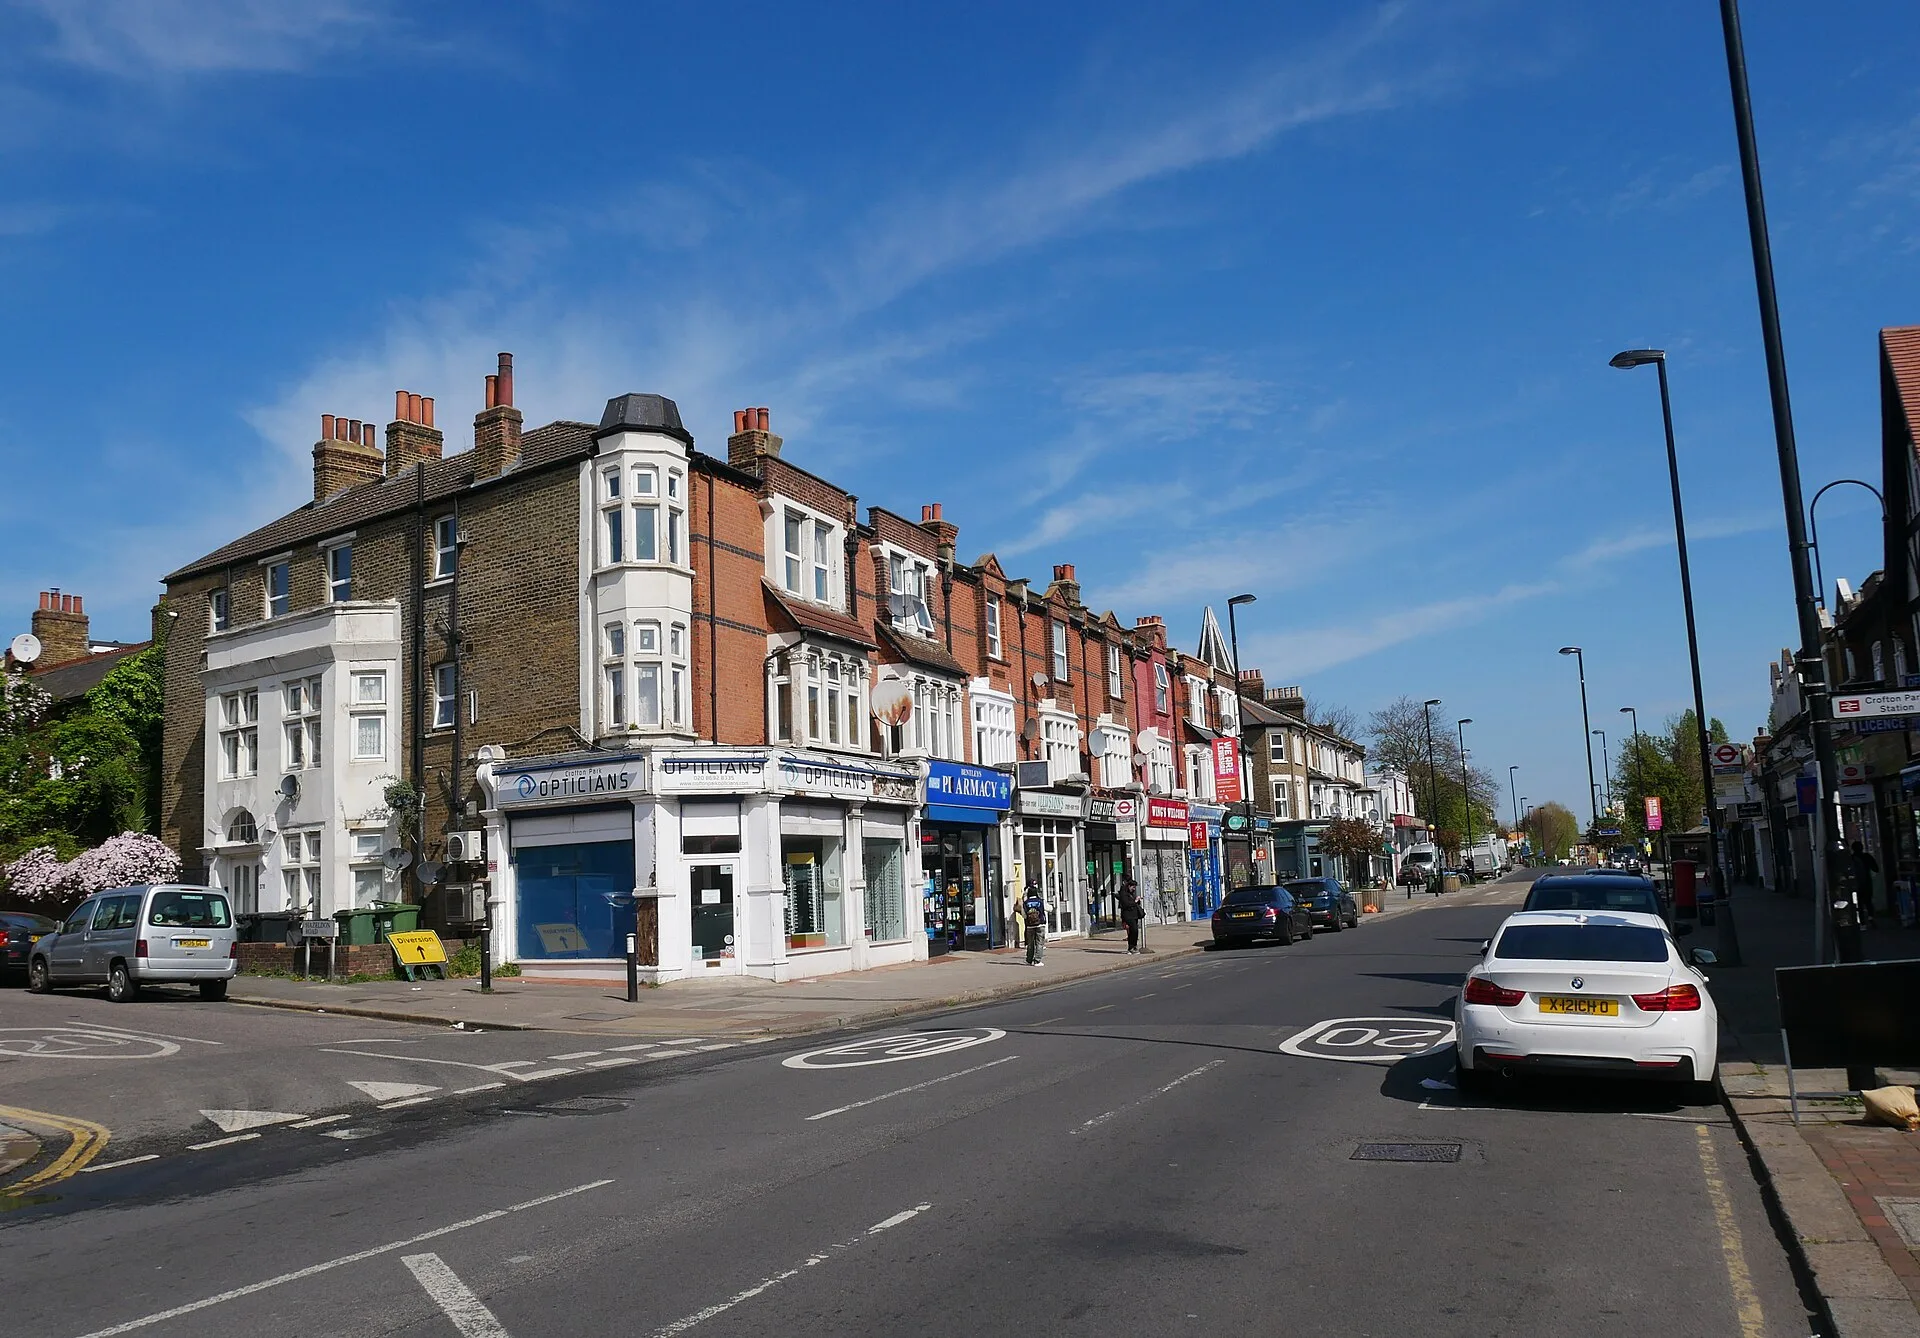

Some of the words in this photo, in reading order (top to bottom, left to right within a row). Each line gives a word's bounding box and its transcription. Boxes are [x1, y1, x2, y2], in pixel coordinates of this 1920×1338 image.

[1865, 695, 1901, 704] Crofton
[1904, 694, 1920, 702] Par
[1880, 704, 1914, 713] Station
[1860, 719, 1906, 732] LICENCE
[1223, 741, 1233, 755] WE
[1225, 756, 1234, 774] ARE
[564, 769, 587, 777] Crofton
[588, 767, 602, 775] Park
[805, 767, 867, 790] OPTICIANS
[539, 772, 628, 797] OPTICIANS
[396, 934, 435, 944] Diversion
[1315, 1027, 1442, 1048] 20
